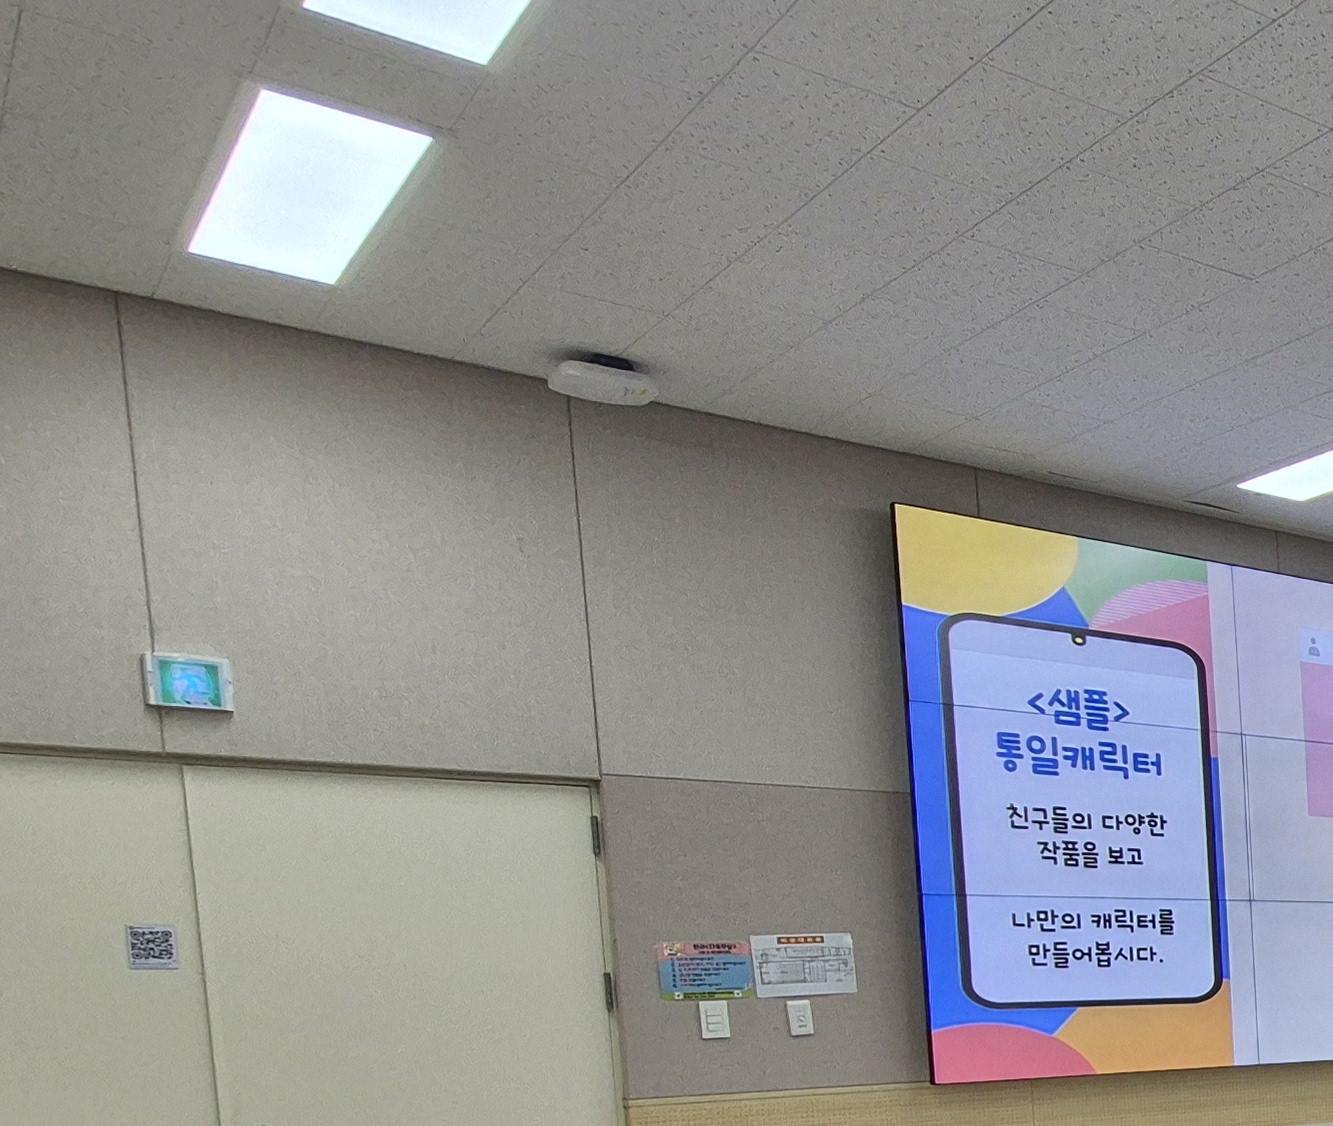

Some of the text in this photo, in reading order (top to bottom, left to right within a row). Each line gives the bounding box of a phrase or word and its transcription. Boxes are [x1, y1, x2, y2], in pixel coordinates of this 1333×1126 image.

[1027, 688, 1130, 732] <샘플>
[996, 731, 1162, 780] 통일캐릭터
[1006, 803, 1167, 837] 친구들의 다양한
[1036, 840, 1144, 869] 작품을 보고
[1011, 909, 1175, 935] 나만의 캐릭터를
[1028, 941, 1164, 968] 만들어봅시다.
